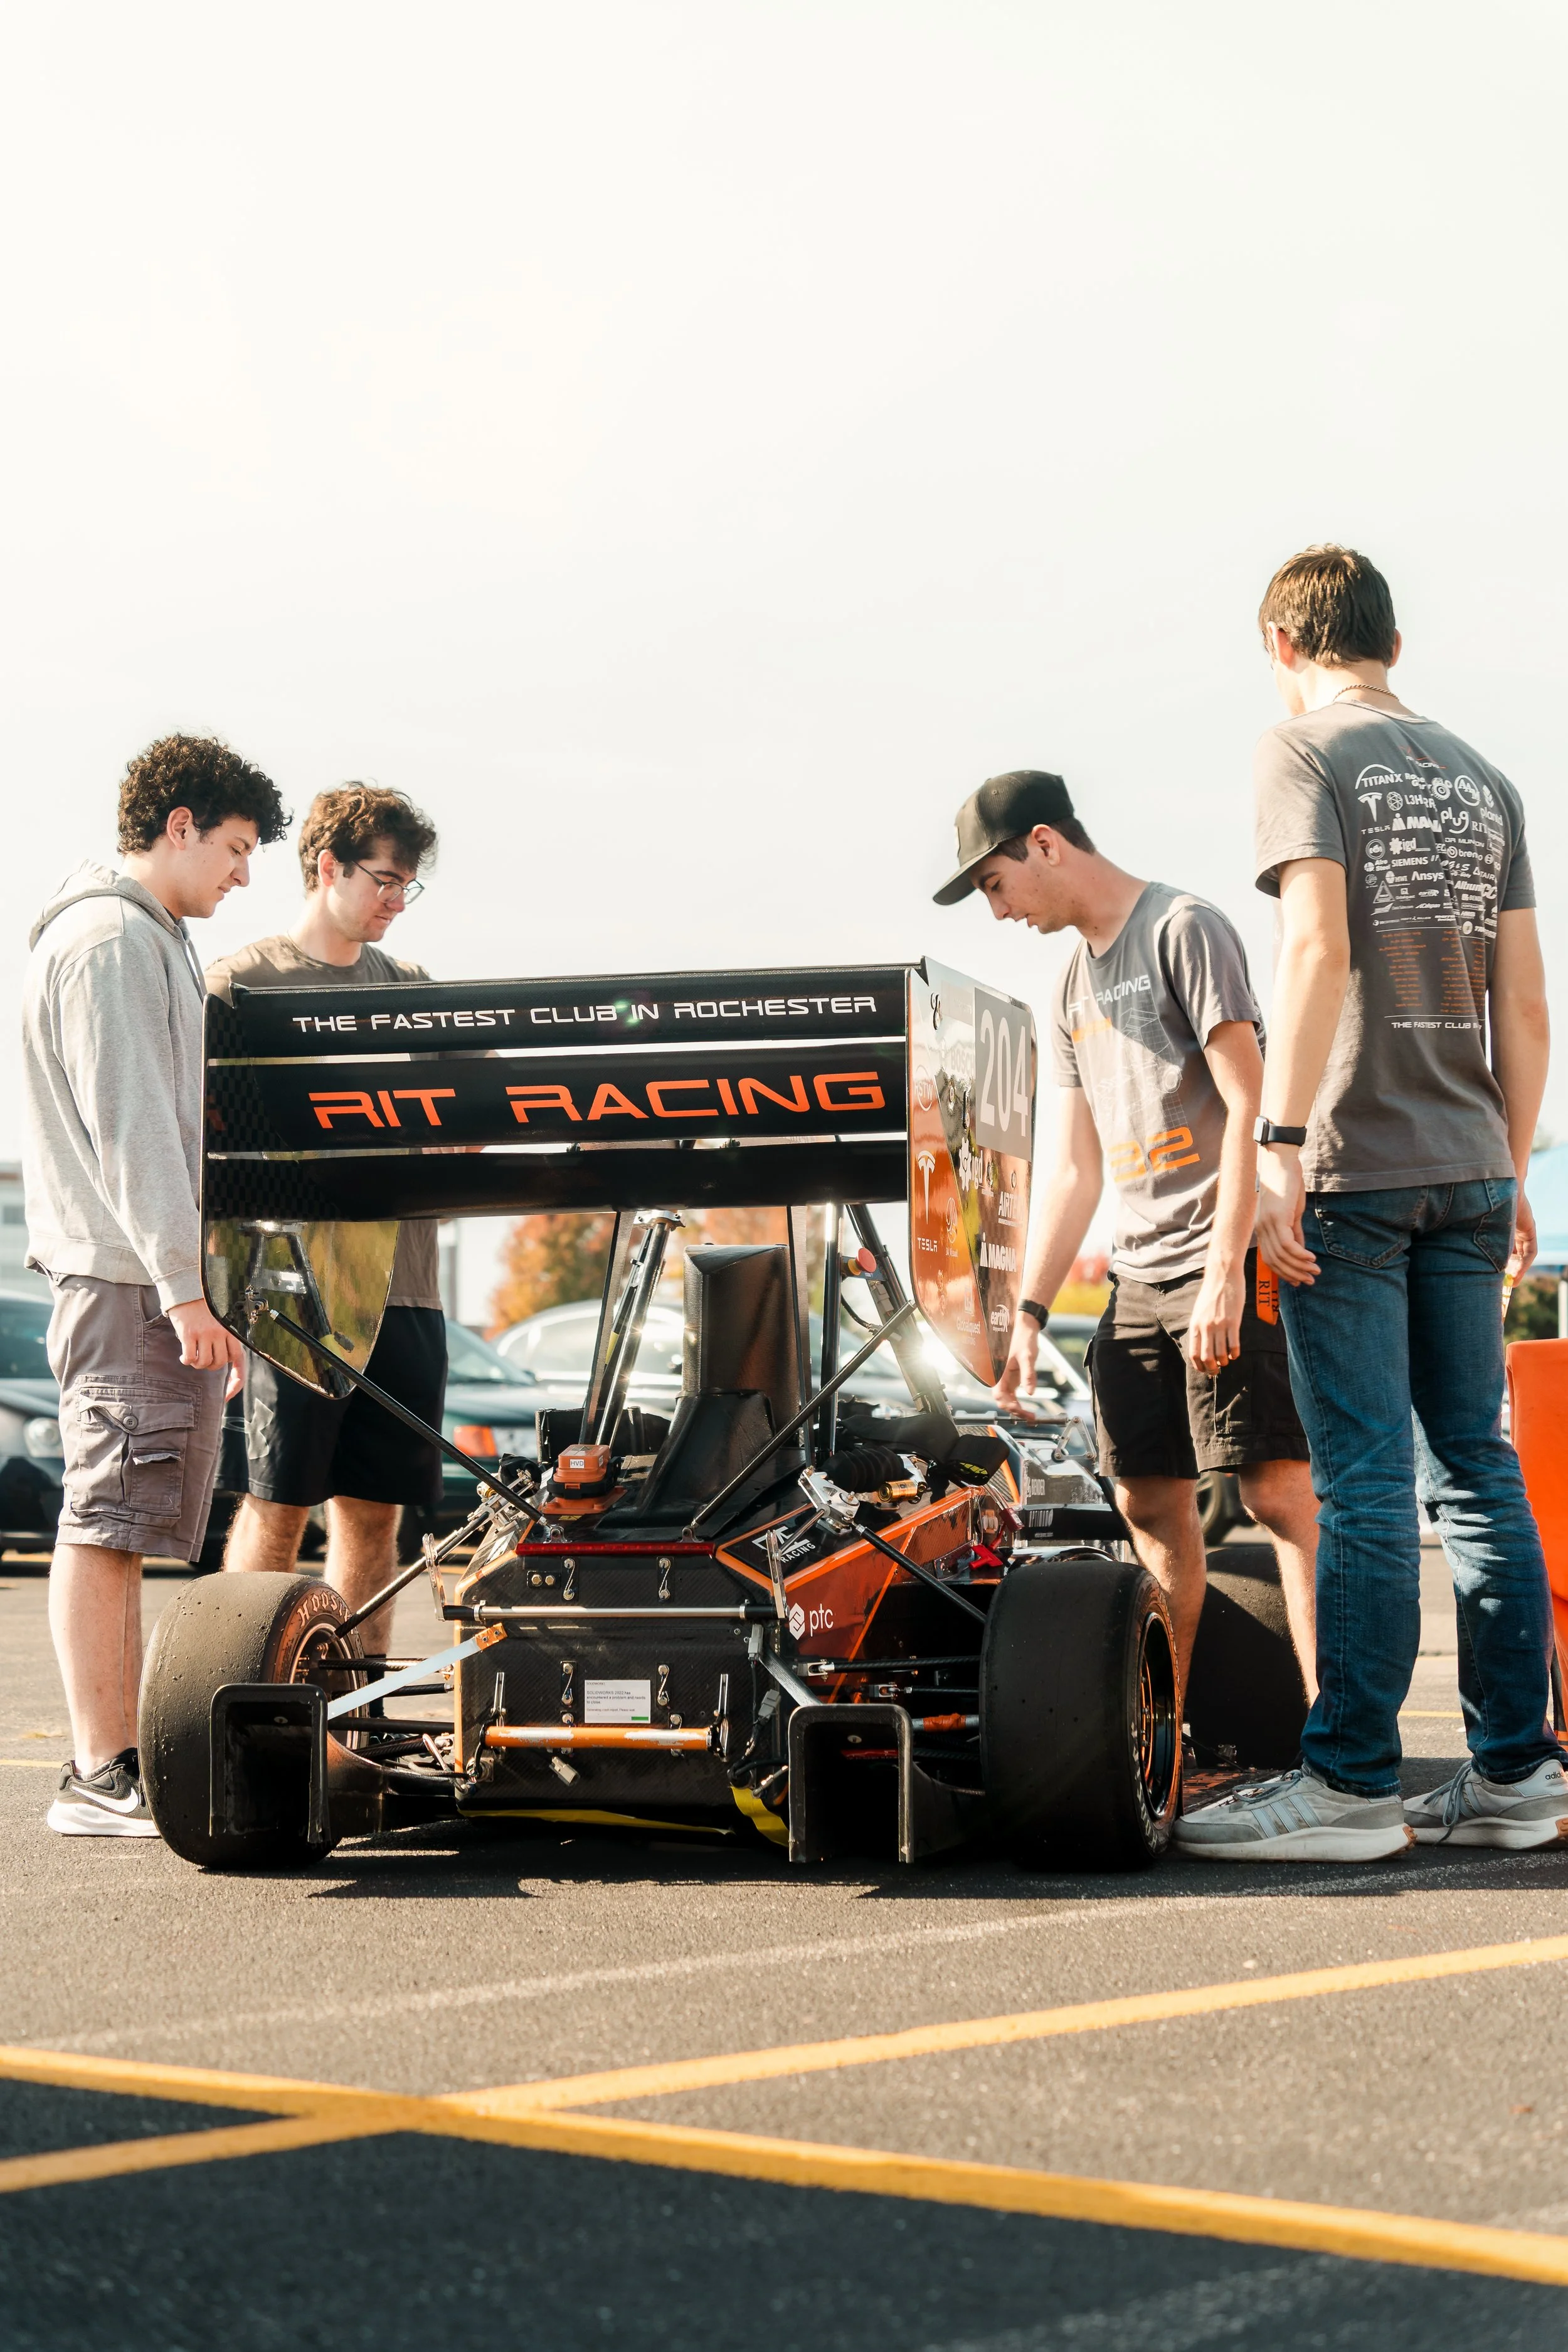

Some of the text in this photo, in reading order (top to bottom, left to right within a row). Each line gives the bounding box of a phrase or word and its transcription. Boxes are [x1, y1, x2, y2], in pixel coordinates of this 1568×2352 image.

[1361, 773, 1404, 788] TITANX
[1361, 825, 1391, 835] TESLA
[1441, 807, 1469, 834] plug
[1471, 820, 1488, 834] RIT
[1391, 856, 1429, 867] SIEMENS
[1411, 871, 1444, 882] Ansys
[1096, 974, 1153, 1005] RACING
[292, 996, 877, 1032] THE FASTEST CLUB IN ROCHESTER
[980, 1009, 1029, 1137] 204
[308, 1071, 886, 1128] RIT RACING
[917, 1237, 938, 1253] TESLA
[988, 1242, 1017, 1273] MAGNA
[1258, 1280, 1270, 1306] RIT
[780, 1542, 816, 1563] RACING
[809, 1603, 834, 1637] ptc
